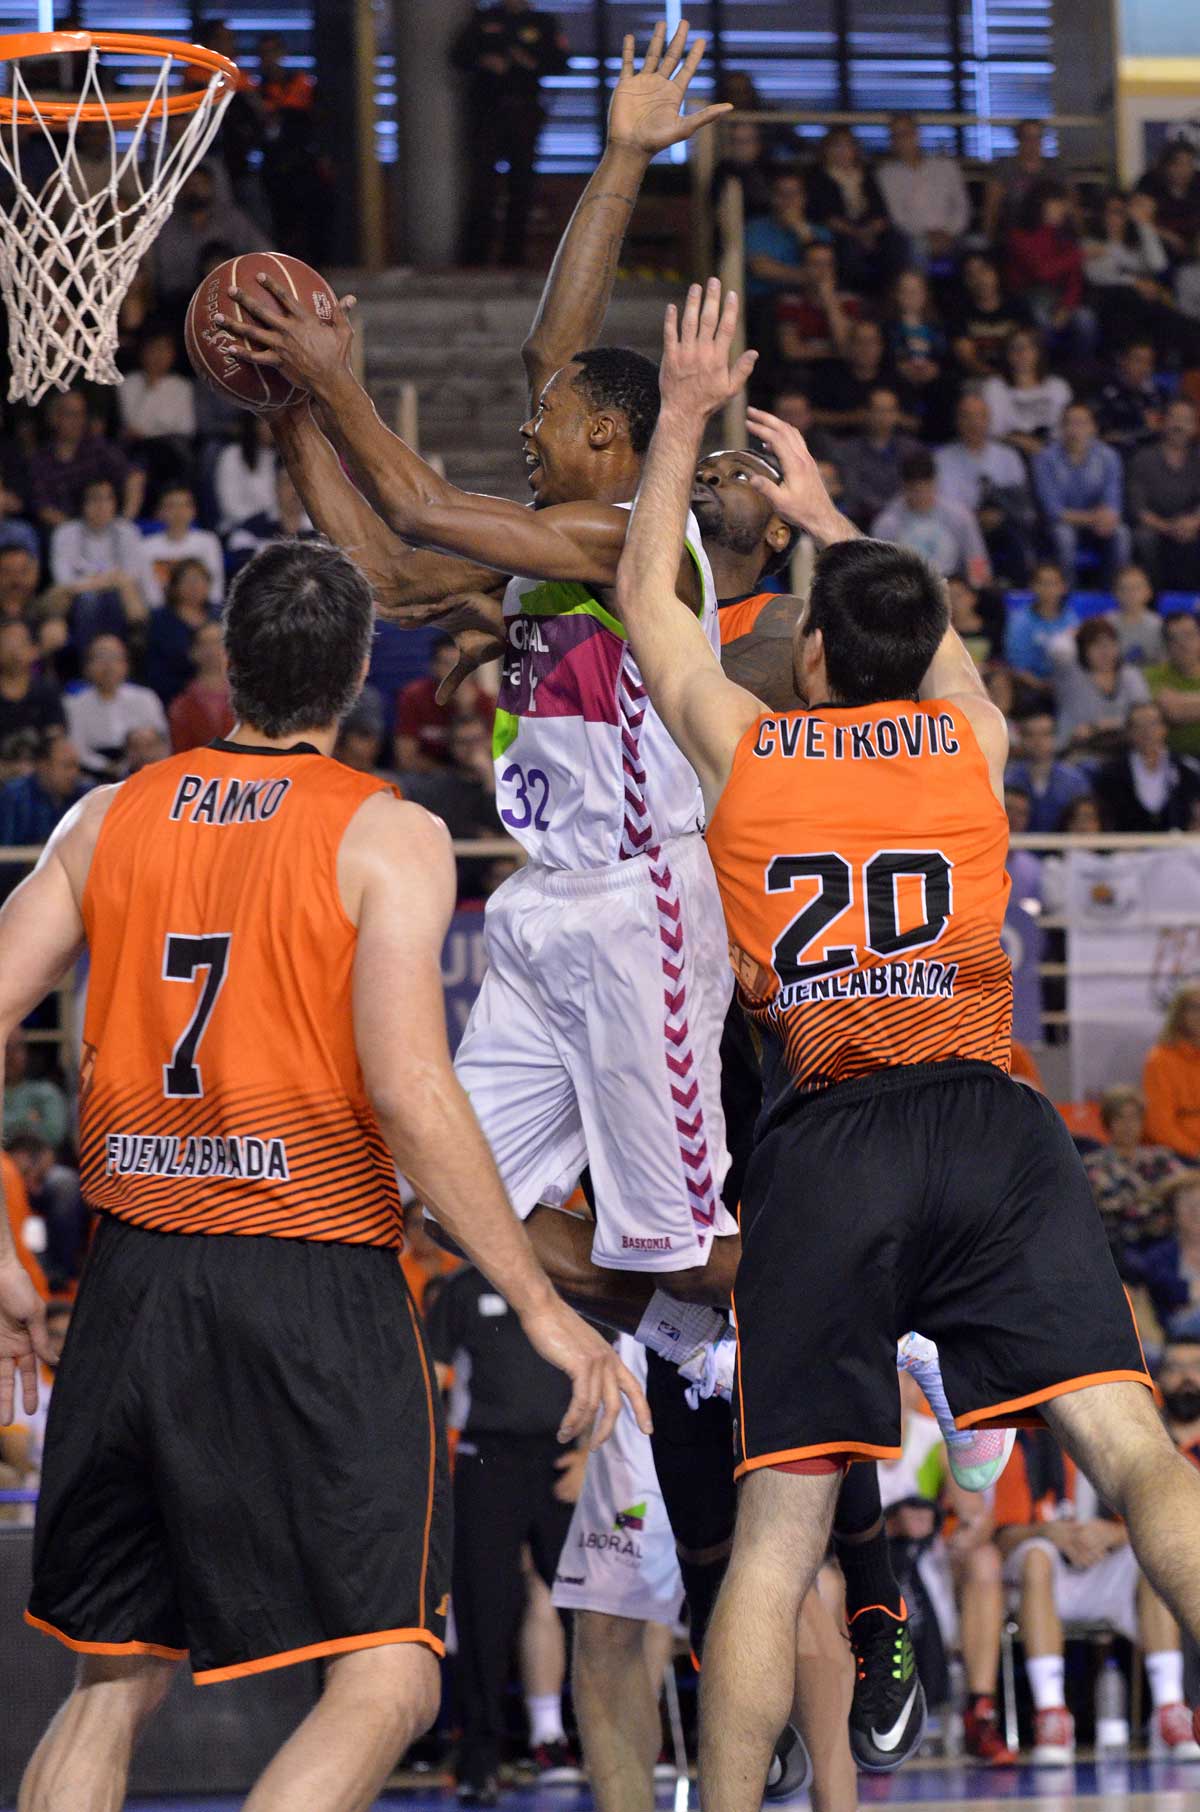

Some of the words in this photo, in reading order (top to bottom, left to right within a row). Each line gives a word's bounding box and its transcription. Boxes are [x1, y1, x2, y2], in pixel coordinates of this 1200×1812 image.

[753, 712, 960, 760] CVETKOVIC
[168, 773, 292, 826] PANKO
[501, 763, 550, 832] 32
[764, 849, 955, 988] 20
[161, 932, 233, 1098] 7
[106, 1133, 290, 1181] FUENLABRADA
[621, 1235, 673, 1250] BASKONIA
